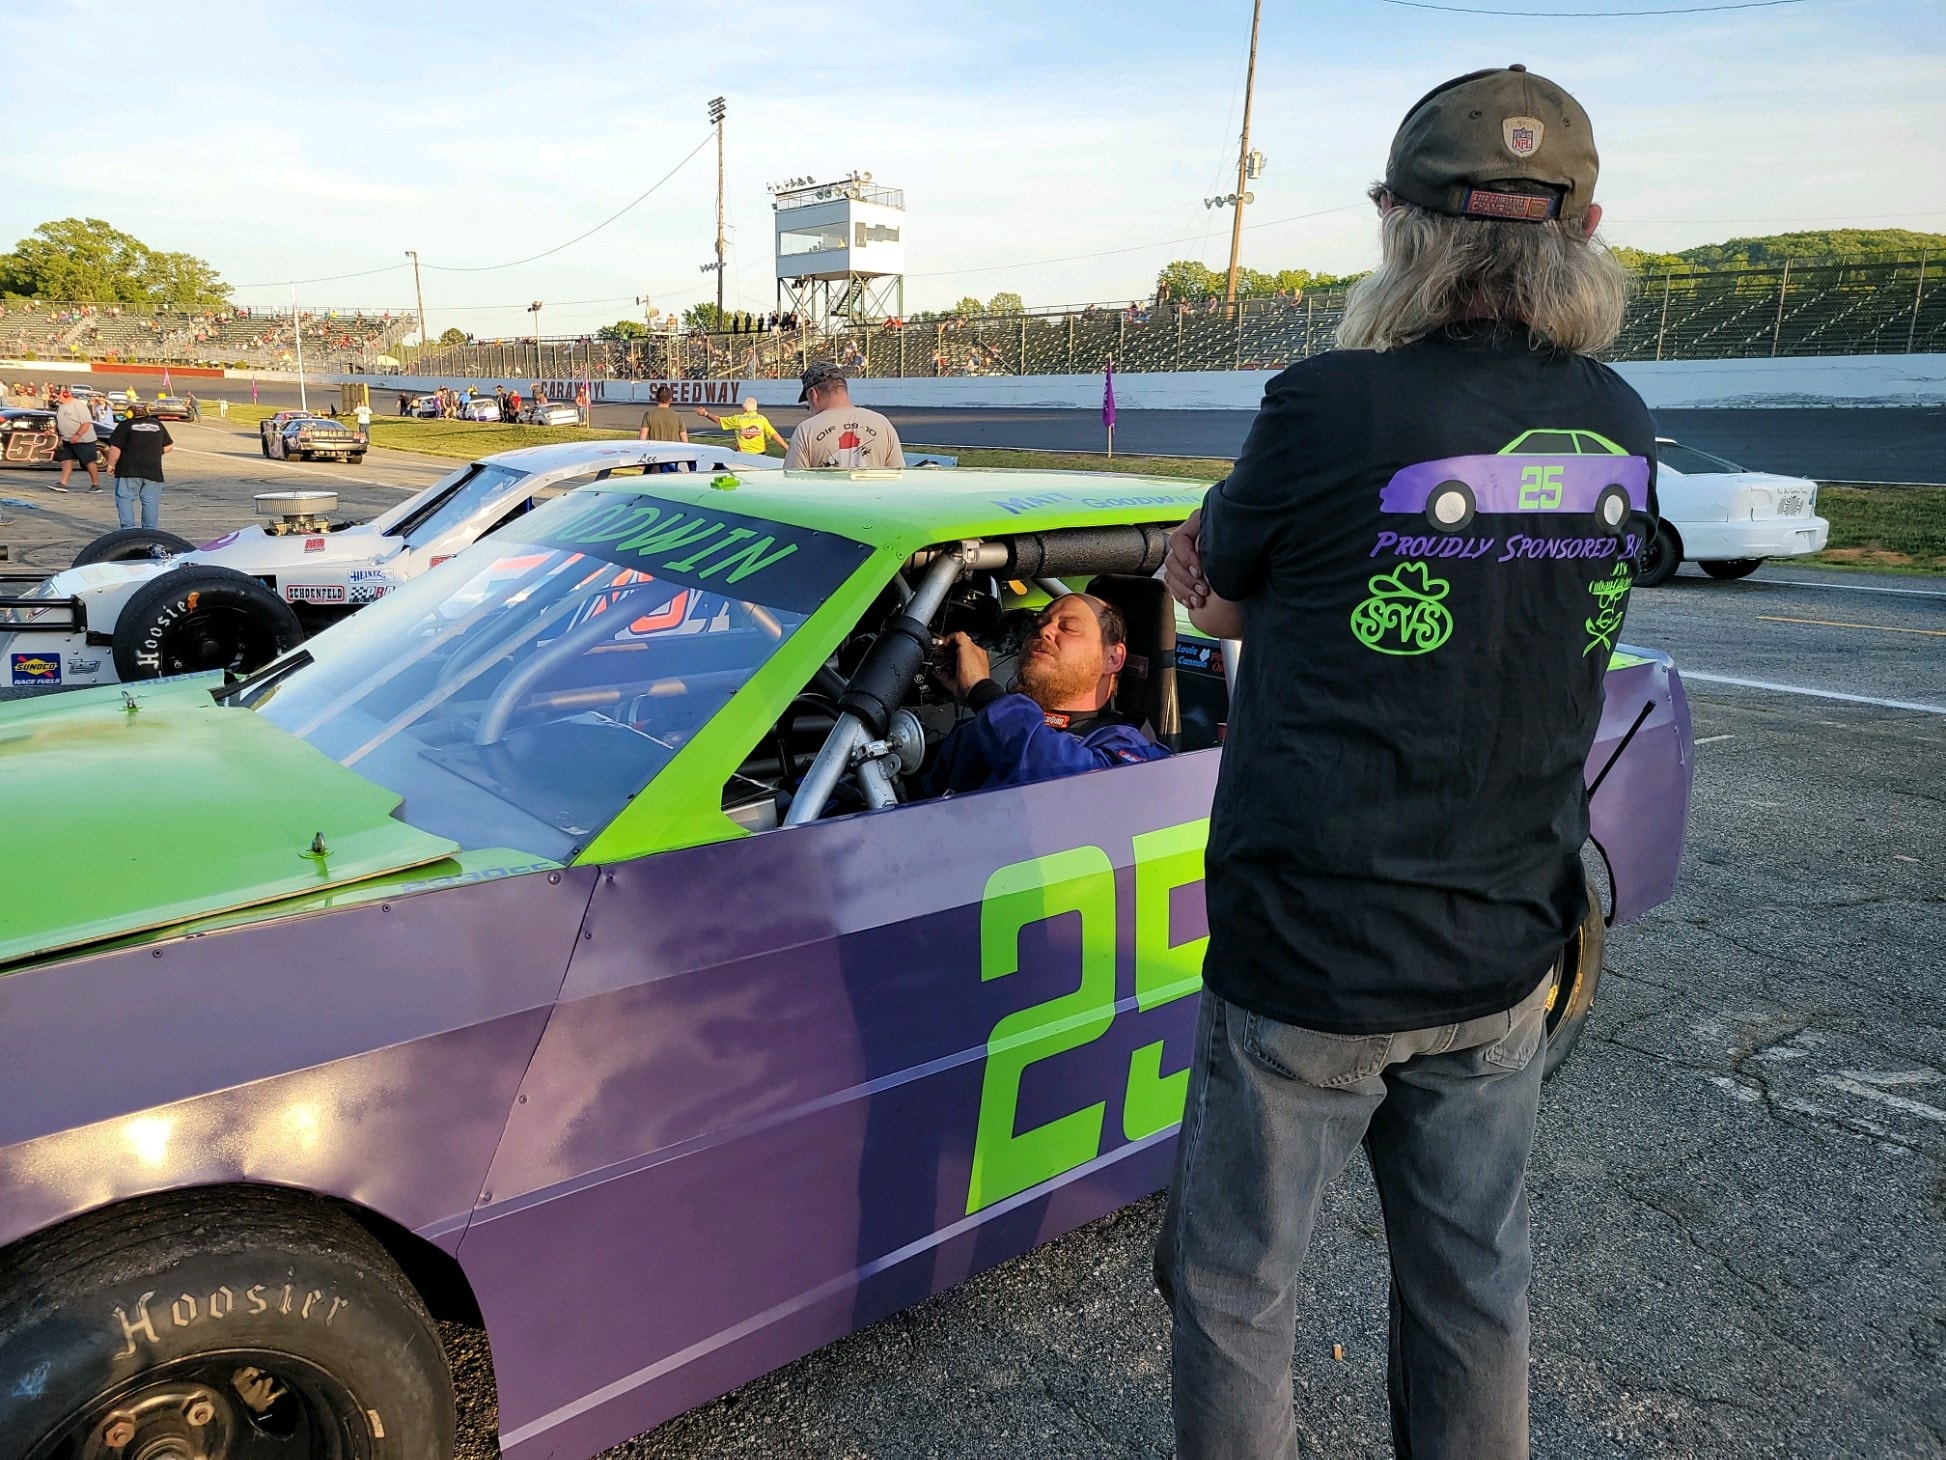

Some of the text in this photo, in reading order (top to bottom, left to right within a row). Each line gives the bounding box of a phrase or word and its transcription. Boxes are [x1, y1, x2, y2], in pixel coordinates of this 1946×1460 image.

[541, 381, 740, 403] CARAWY SEEDWAY
[816, 422, 878, 442] OIF 09-10
[6, 432, 59, 461] 52
[637, 453, 657, 463] Lee
[1518, 465, 1564, 510] 25
[1369, 531, 1495, 560] PROUDLY
[1498, 534, 1618, 563] SPONSORED
[289, 587, 343, 599] SCHOENFELD
[17, 663, 56, 671] SUNOCO
[965, 817, 1211, 1215] 25
[112, 1266, 350, 1360] Hoosier
